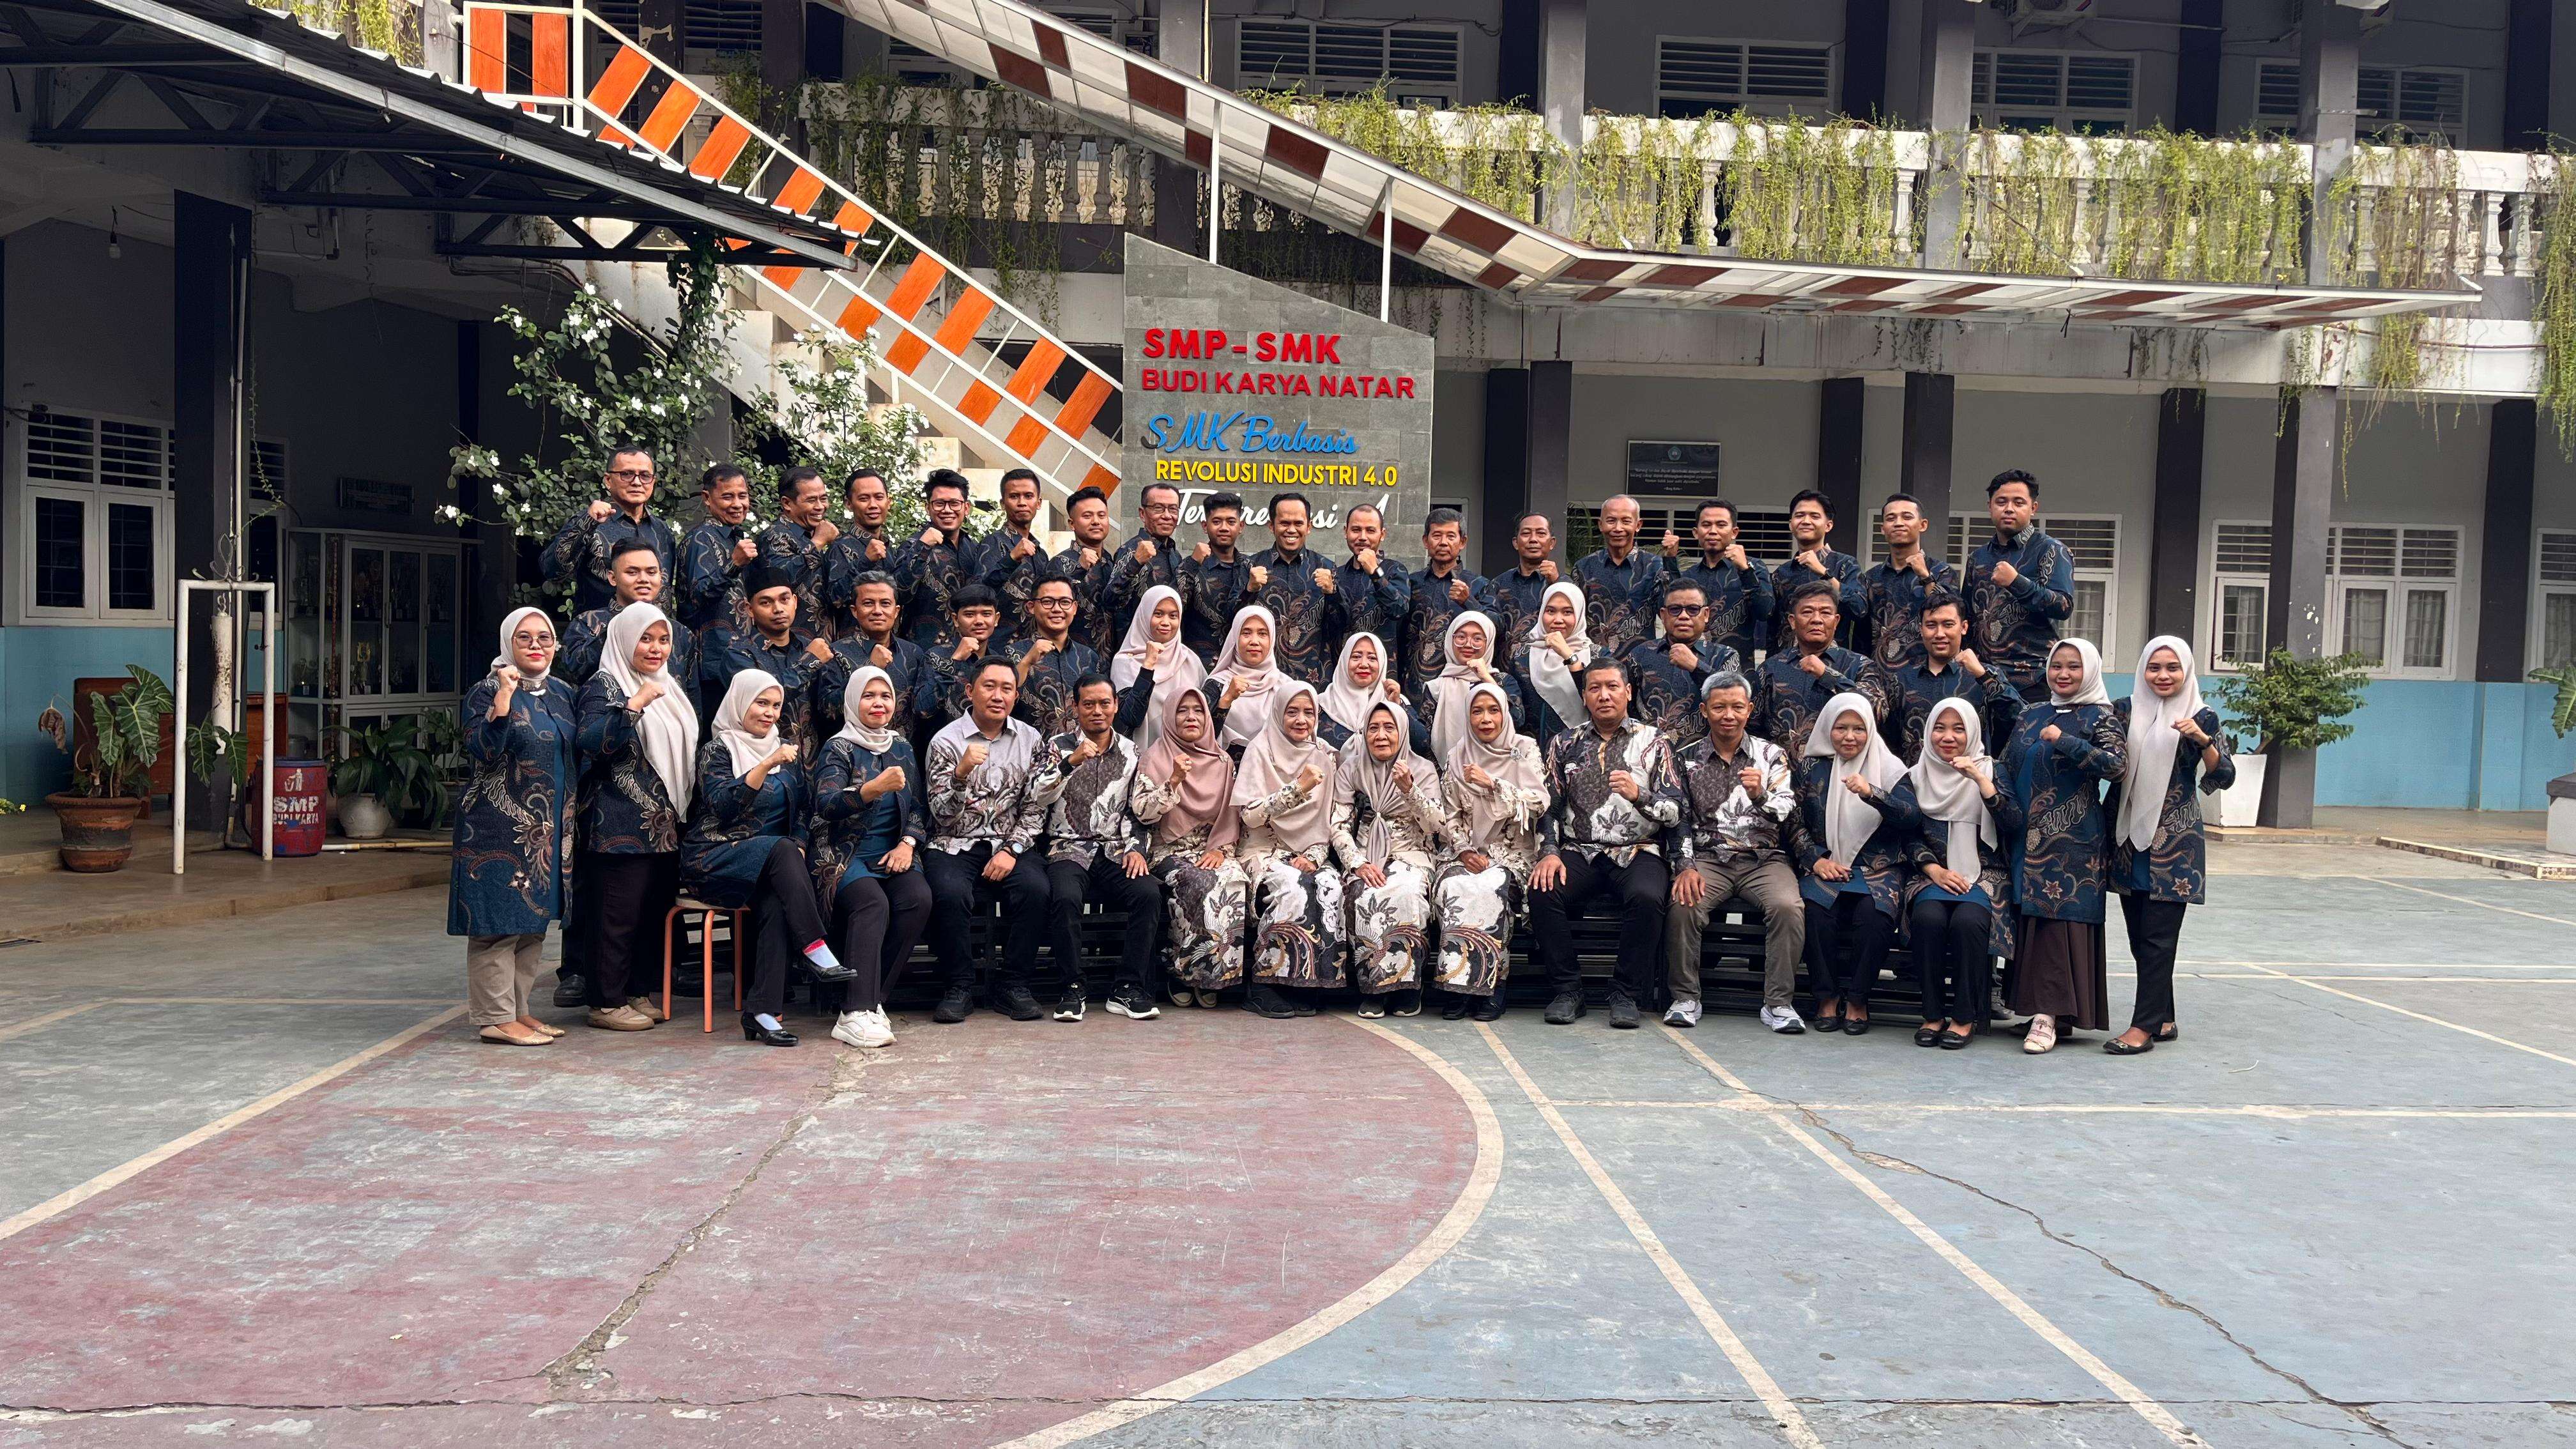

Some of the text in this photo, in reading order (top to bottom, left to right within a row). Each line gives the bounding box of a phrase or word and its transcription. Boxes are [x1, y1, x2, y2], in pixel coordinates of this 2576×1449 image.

[1142, 368, 1414, 399] BUDI KARYA NATAR
[1140, 410, 1360, 454] SMK Berbasis
[1156, 460, 1398, 487] REVOLUSI INDUSTRI 4.0
[273, 795, 319, 813] SMP
